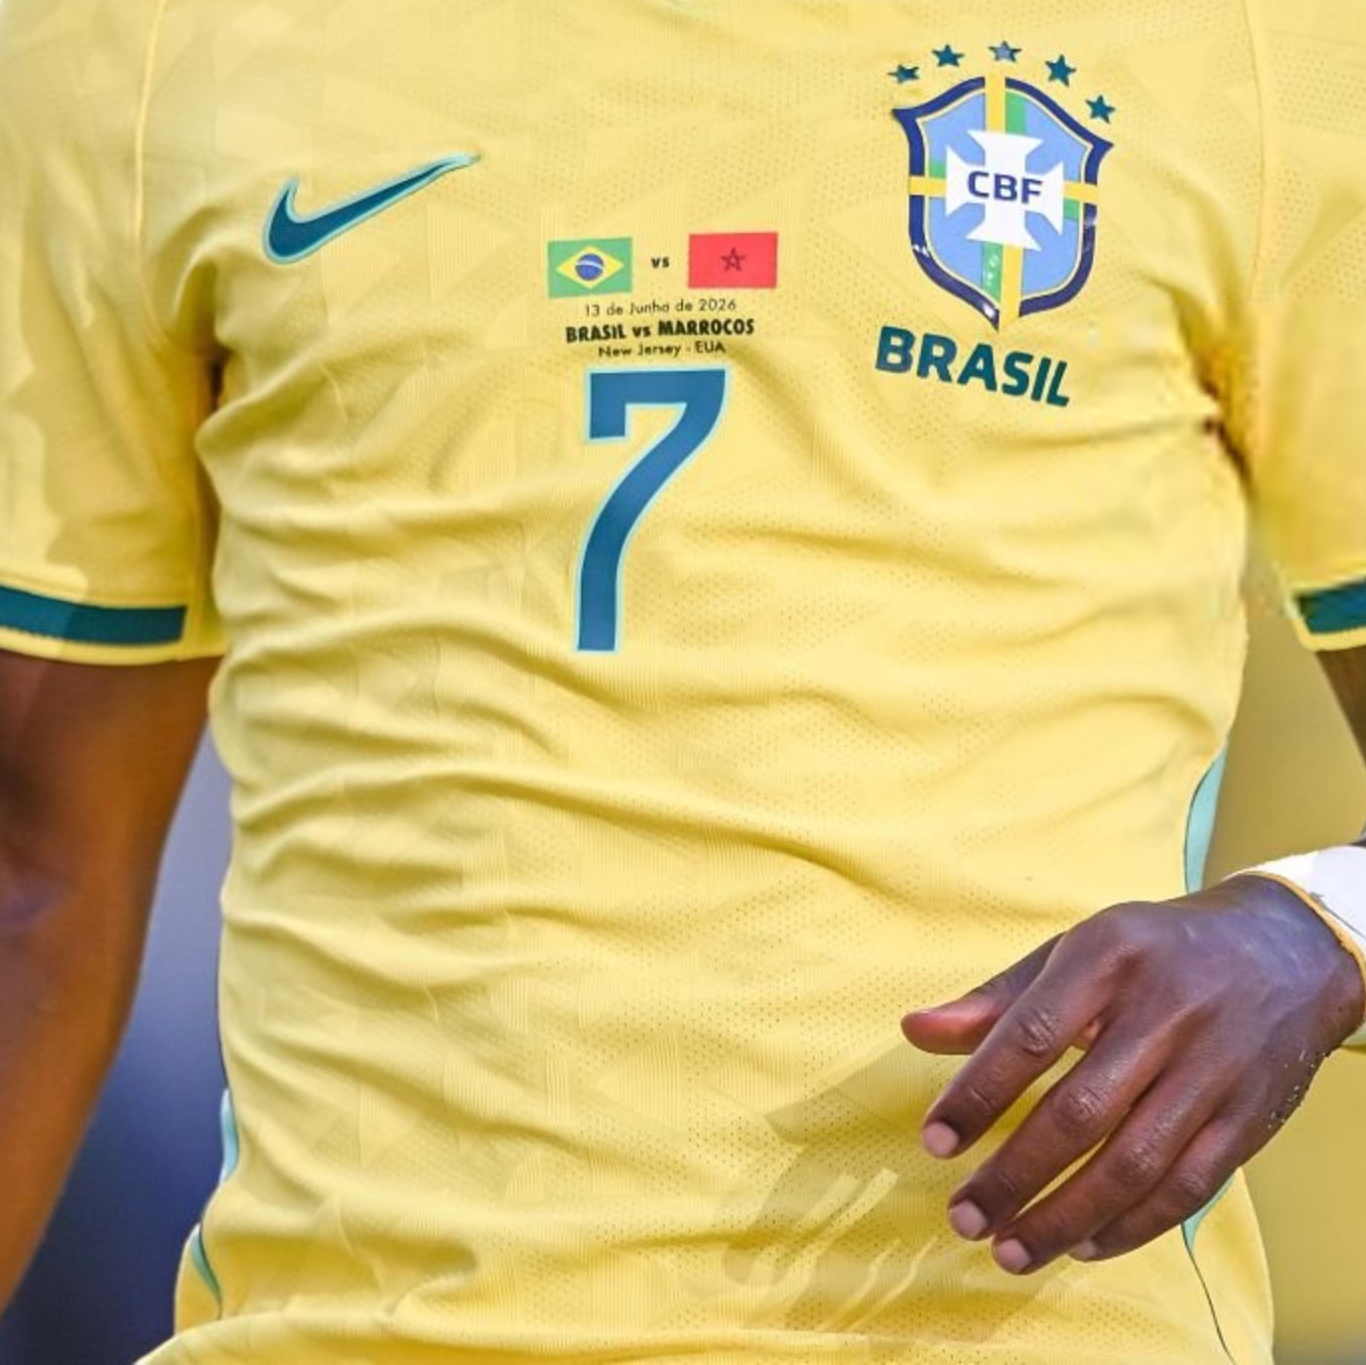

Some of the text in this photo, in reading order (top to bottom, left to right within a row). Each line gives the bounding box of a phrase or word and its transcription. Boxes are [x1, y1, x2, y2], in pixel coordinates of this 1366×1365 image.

[966, 170, 1043, 204] CBF
[651, 256, 670, 269] vs
[585, 298, 737, 317] 13 de Junho de 2026
[565, 318, 755, 344] BRASIL vs MARROCOS
[598, 346, 632, 358] New
[637, 343, 682, 358] Jersey
[695, 341, 726, 354] EUA
[874, 325, 1071, 408] BRASIL
[576, 368, 727, 652] 7
